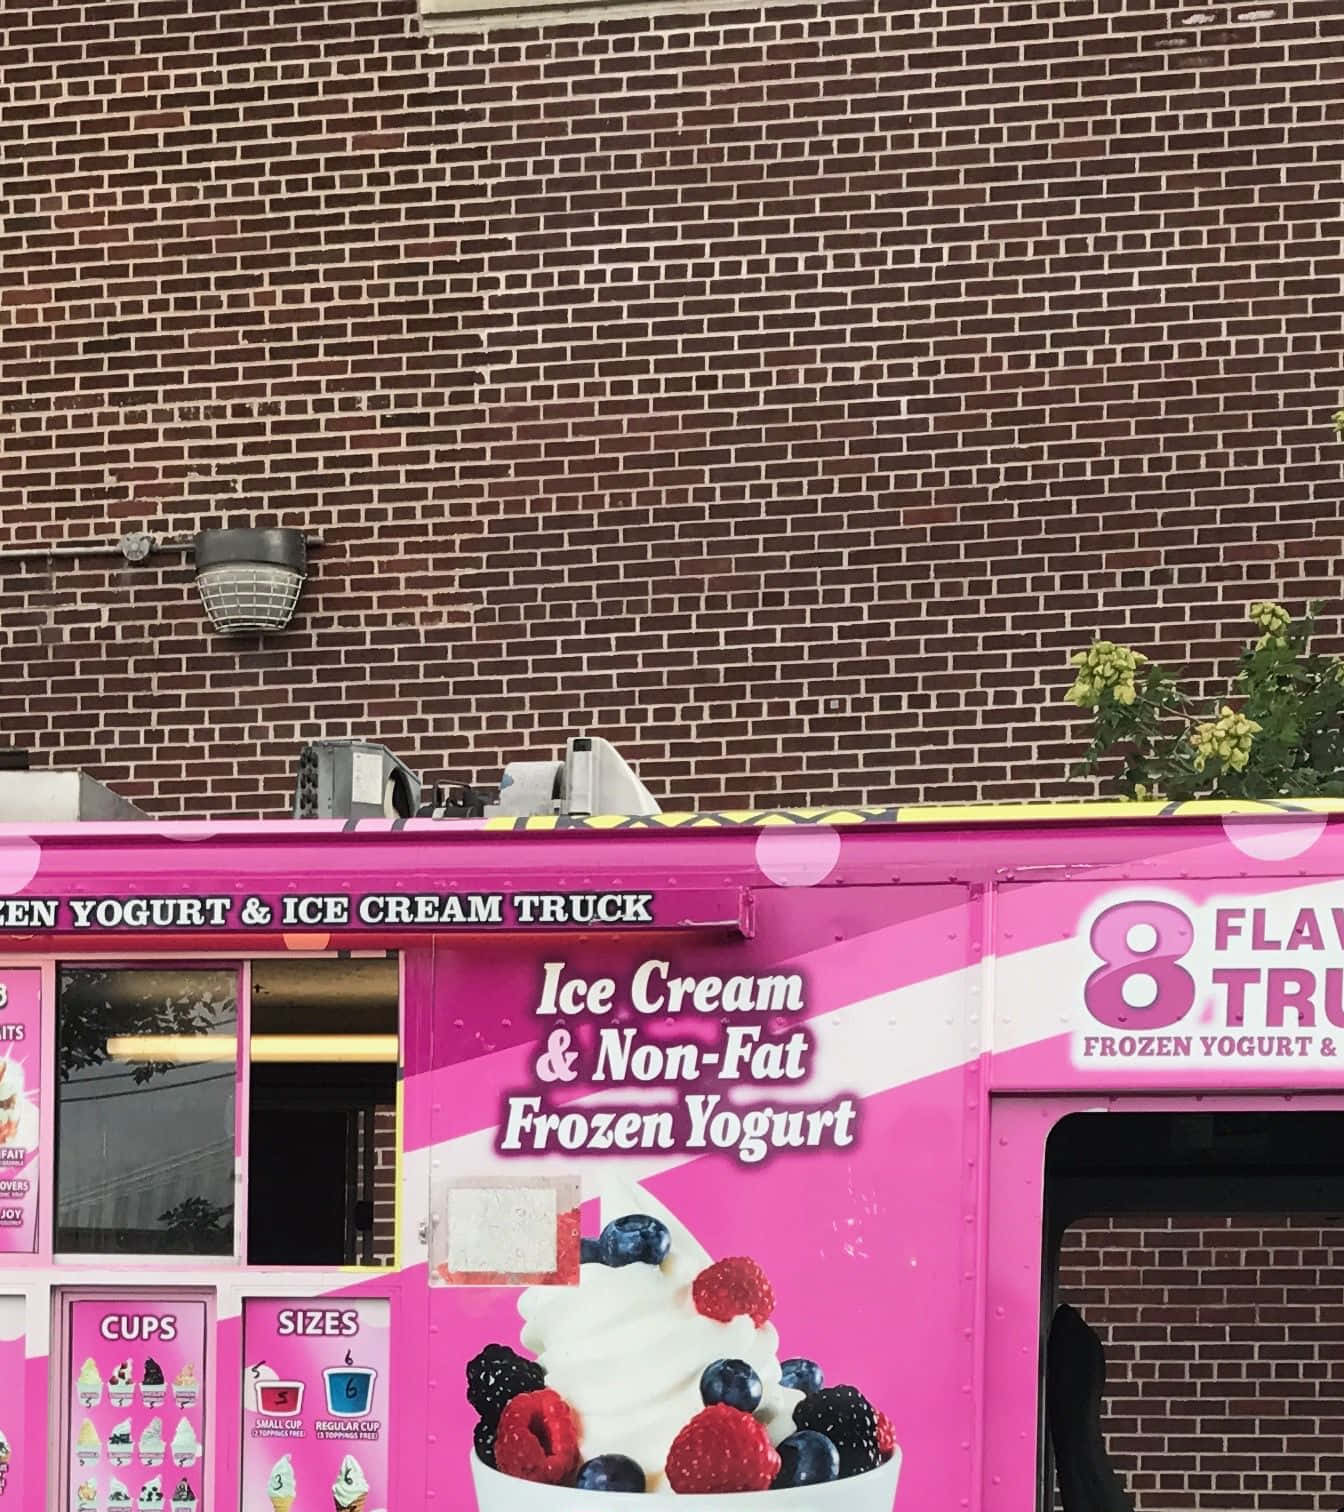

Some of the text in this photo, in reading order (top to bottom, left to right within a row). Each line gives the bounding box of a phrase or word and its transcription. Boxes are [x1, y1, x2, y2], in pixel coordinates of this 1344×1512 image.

[70, 899, 230, 926] YOGURT
[241, 897, 270, 924] &
[282, 897, 349, 924] ICE
[359, 896, 502, 923] CREAM
[514, 894, 653, 922] TRUCK
[1084, 899, 1196, 1031] 8
[536, 959, 804, 1015] Ice Cream
[535, 1025, 808, 1083] & Non-Fat
[1083, 1036, 1193, 1057] FROZEN
[1202, 1036, 1313, 1058] YOGURT
[1319, 1036, 1337, 1058] &
[500, 1095, 856, 1164] Frozen Yogurt
[0, 1208, 22, 1220] JOY
[100, 1315, 177, 1340] CUPS
[278, 1310, 359, 1335] SIZES
[344, 1349, 354, 1366] 6
[346, 1376, 358, 1399] 6
[256, 1419, 302, 1429] SMALL CUP
[315, 1421, 380, 1432] REGULAR CUP
[273, 1473, 283, 1491] 3
